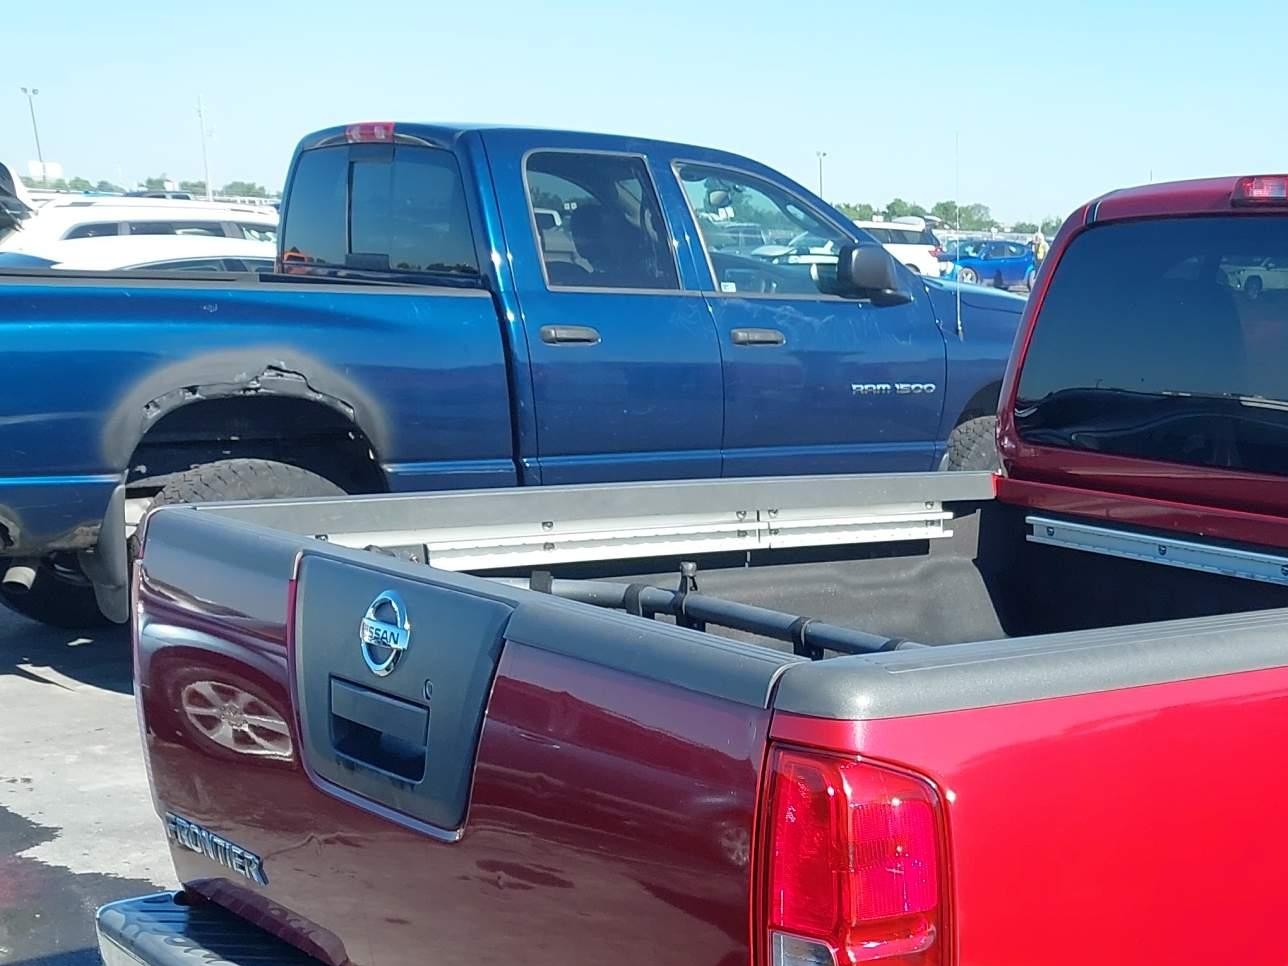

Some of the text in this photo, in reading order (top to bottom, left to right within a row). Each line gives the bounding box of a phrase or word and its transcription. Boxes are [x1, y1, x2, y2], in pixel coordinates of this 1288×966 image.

[851, 383, 936, 395] RAM 1500
[363, 623, 400, 645] SSAN
[165, 811, 269, 887] FRONTIER
